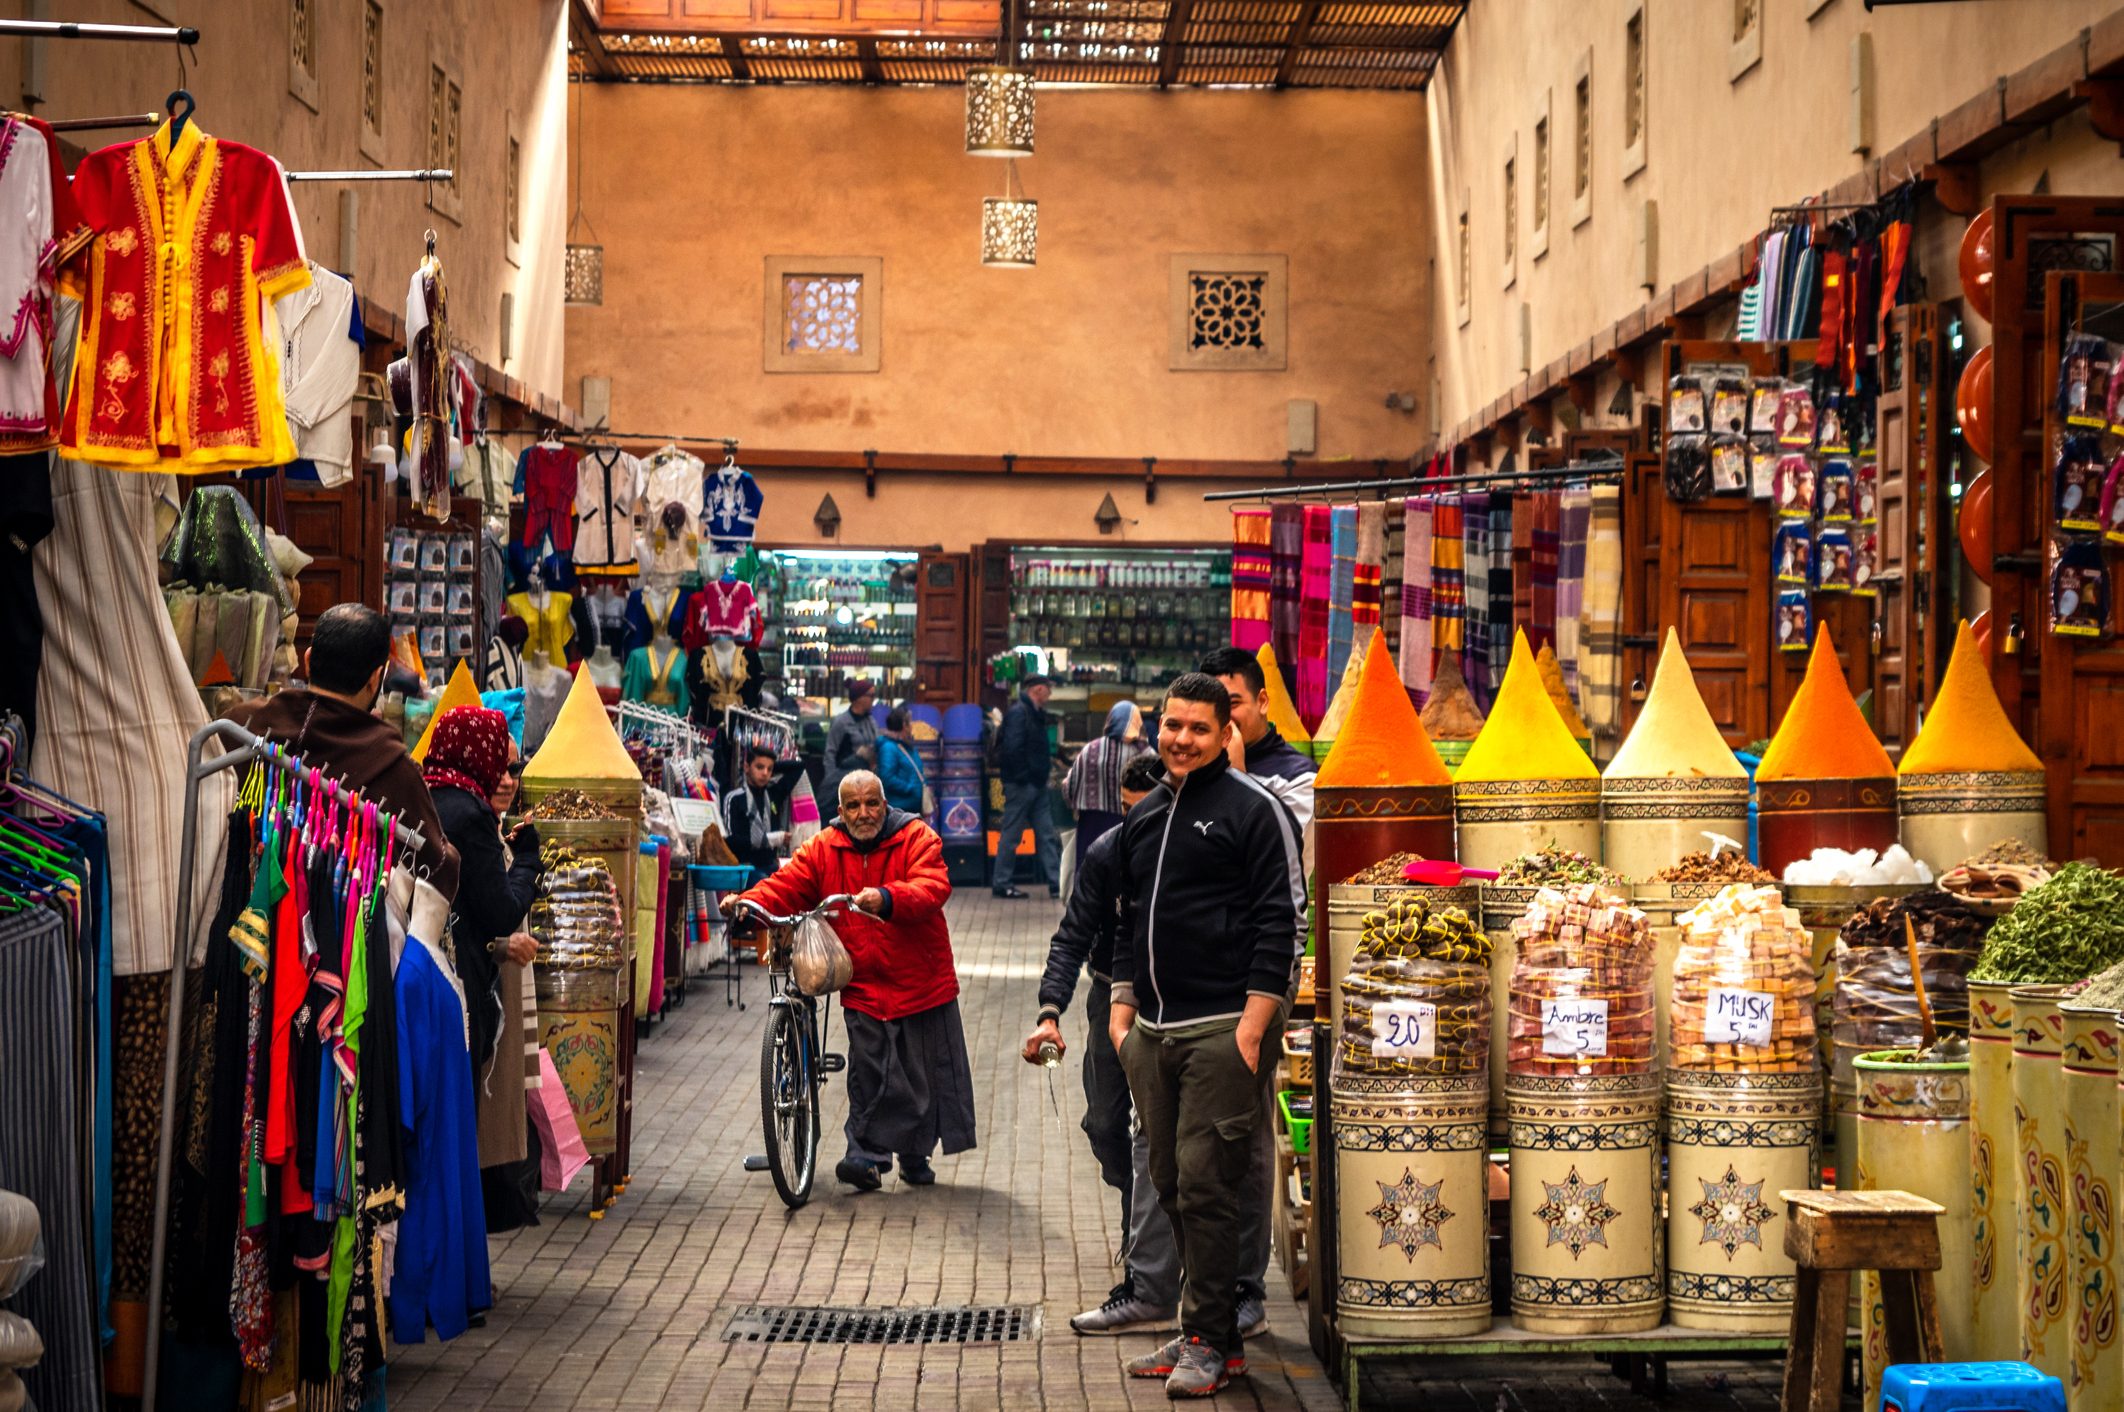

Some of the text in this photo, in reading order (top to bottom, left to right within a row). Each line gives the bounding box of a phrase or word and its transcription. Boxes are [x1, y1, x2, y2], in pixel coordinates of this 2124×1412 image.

[1548, 1005, 1604, 1025] Ambre
[1718, 993, 1771, 1022] MUSK
[1385, 1013, 1420, 1047] 20
[1576, 1029, 1589, 1051] 5
[1728, 1021, 1742, 1044] 5
